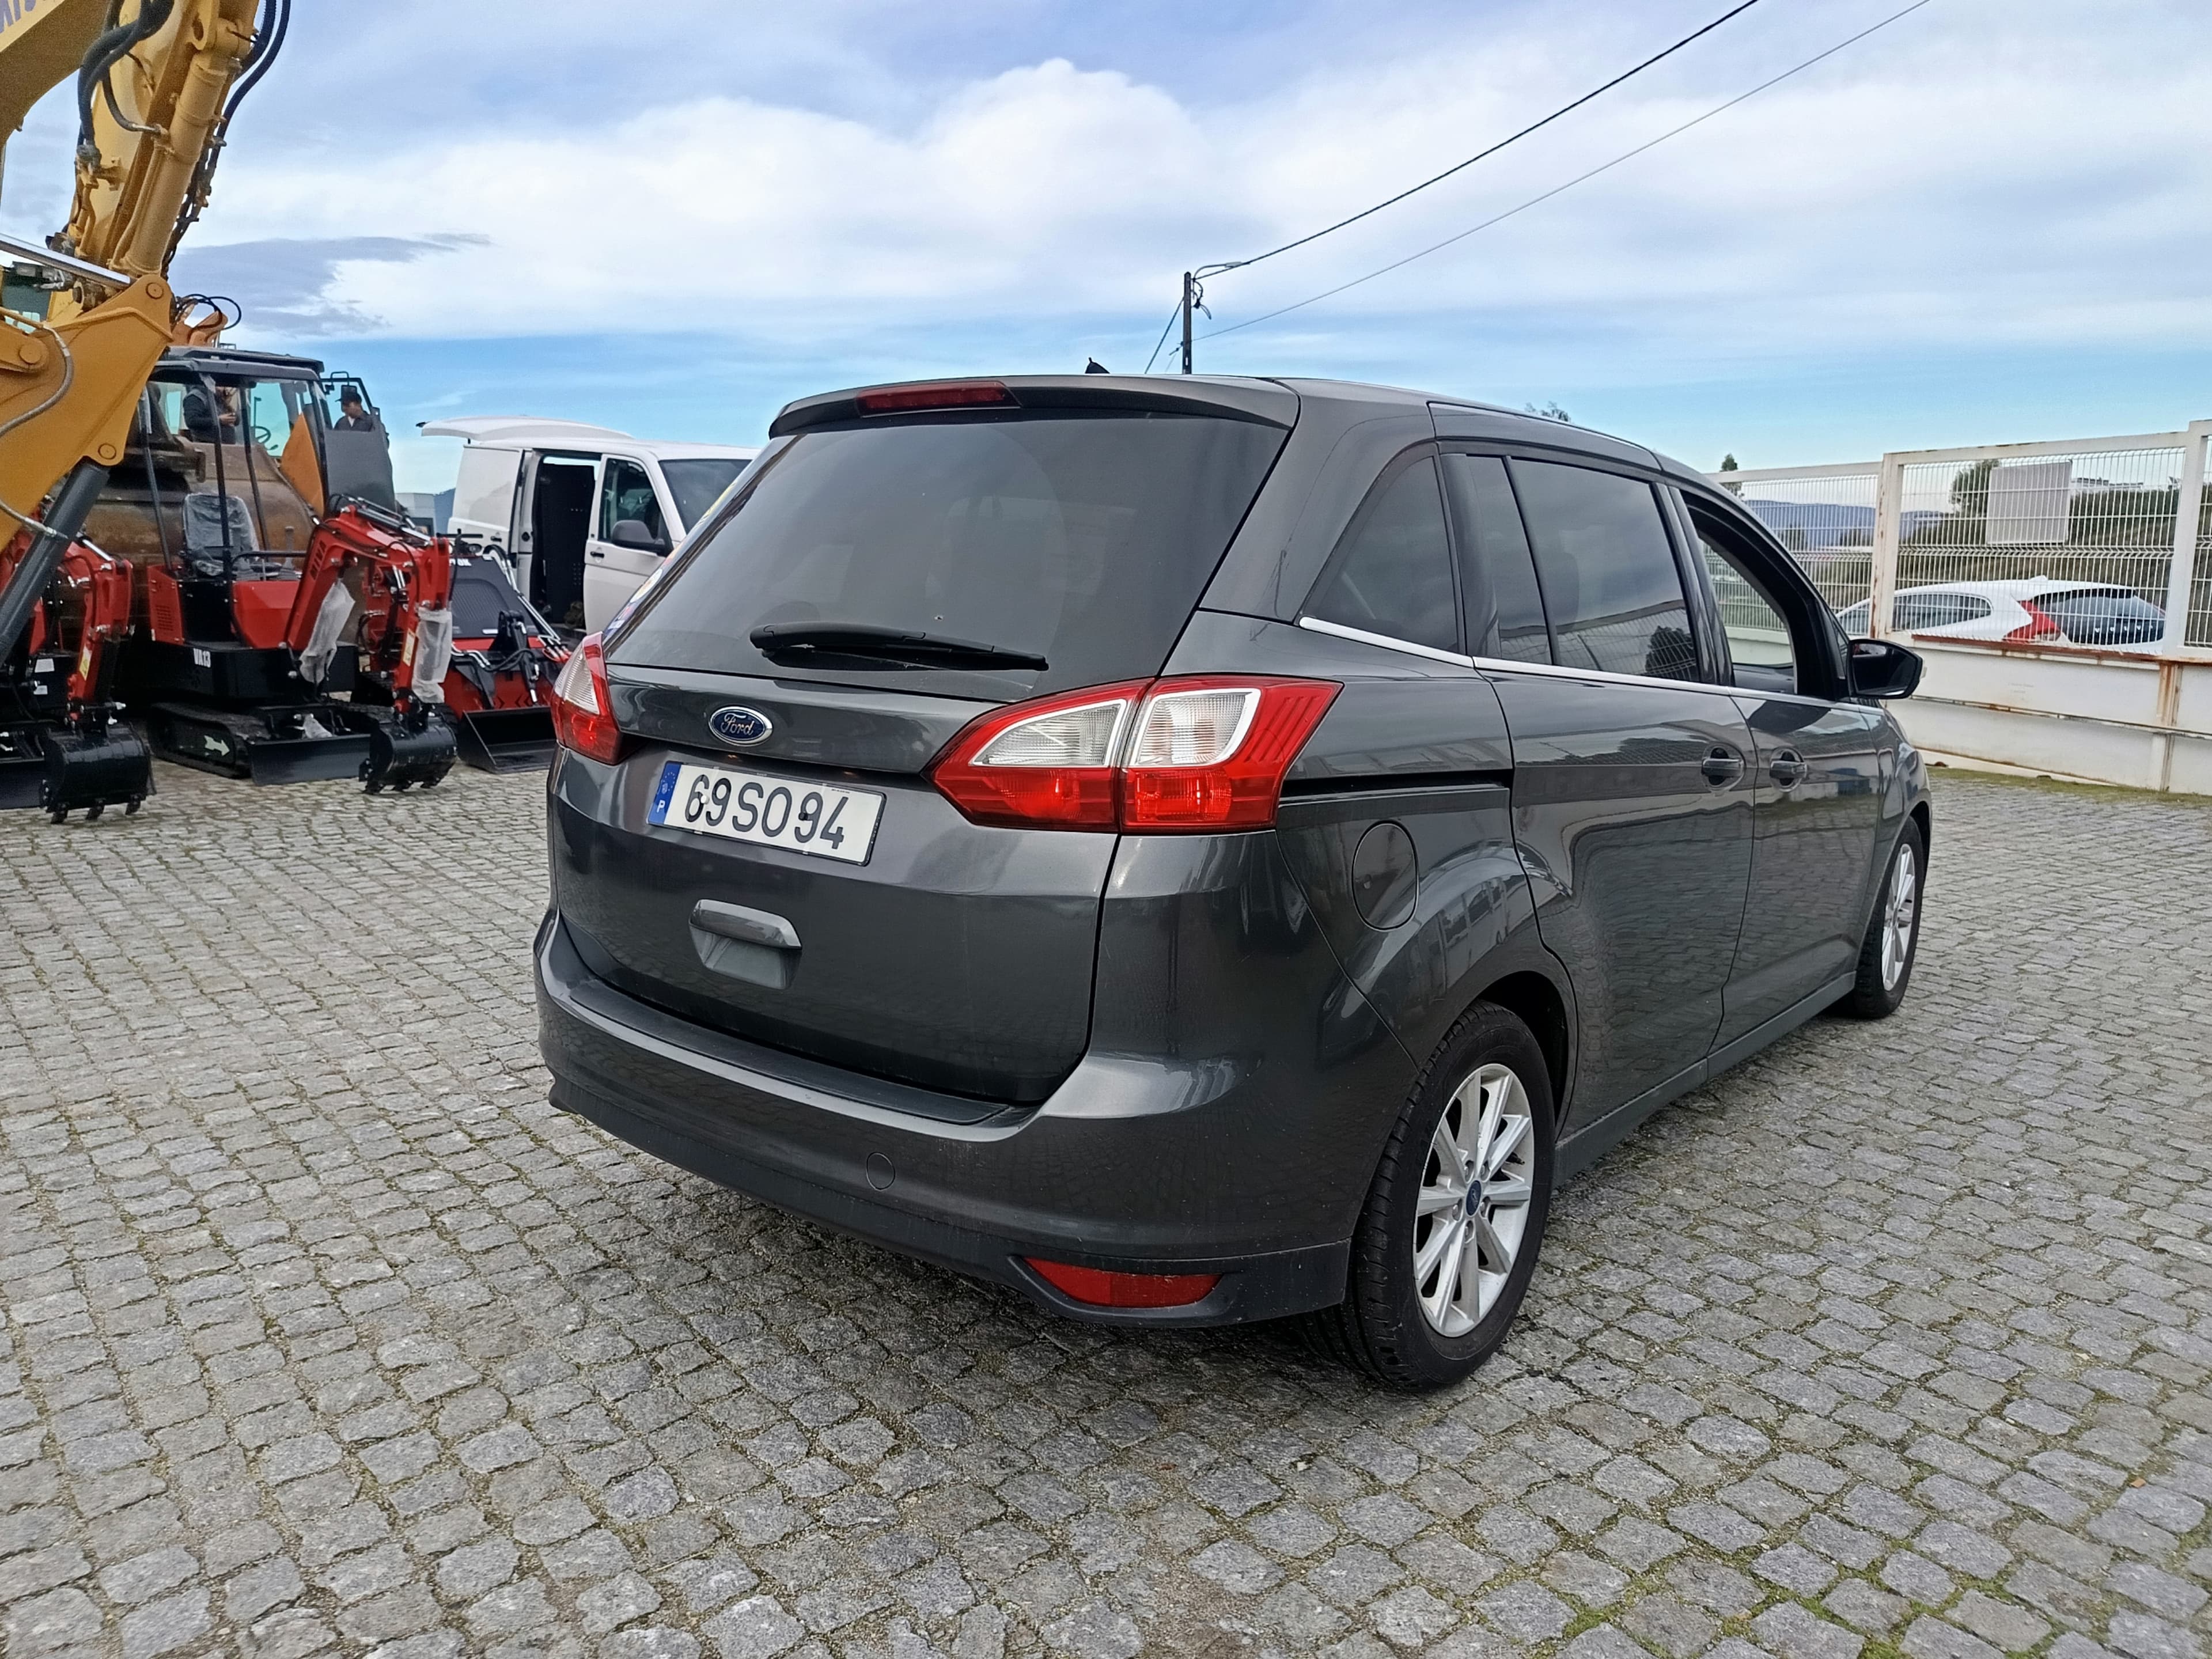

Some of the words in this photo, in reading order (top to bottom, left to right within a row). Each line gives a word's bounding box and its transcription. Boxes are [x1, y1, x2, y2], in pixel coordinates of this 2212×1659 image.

[194, 648, 211, 668] VA13
[720, 713, 755, 736] Ford
[656, 800, 666, 813] P
